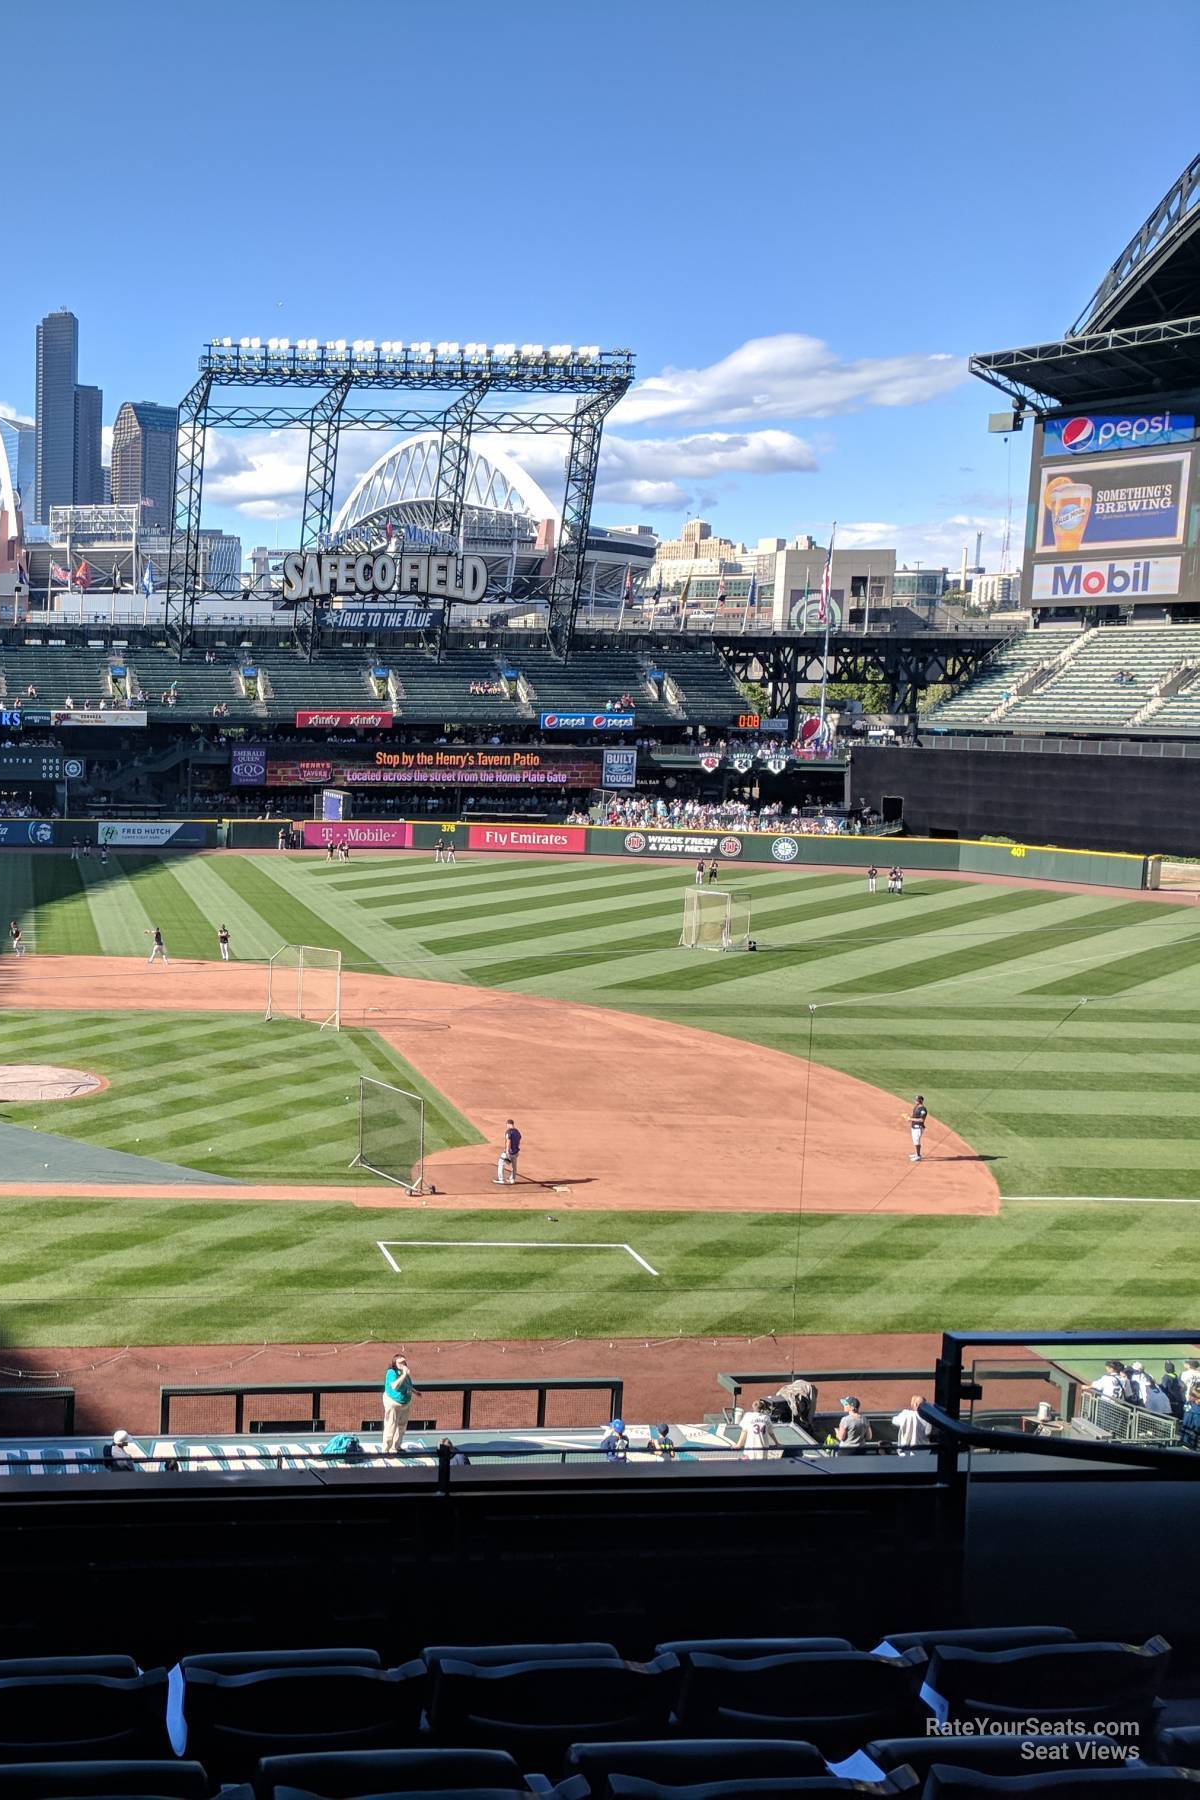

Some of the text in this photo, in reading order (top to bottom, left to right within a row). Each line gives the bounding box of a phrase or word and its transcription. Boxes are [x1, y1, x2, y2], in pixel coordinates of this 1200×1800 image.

[1099, 412, 1171, 444] pepsi
[1096, 484, 1172, 502] SOMETHING'S
[1094, 498, 1172, 515] BREWING
[284, 552, 488, 604] SAFECO FIELD
[1051, 561, 1151, 595] Mobil
[338, 609, 433, 627] TRUE TO THE BLUE
[308, 714, 340, 726] xfinity
[350, 714, 382, 726] xfinity
[560, 717, 585, 727] pepsi
[607, 717, 633, 727] pepsi
[375, 752, 540, 768] Stop by the Henry's Tavern Patio
[606, 754, 633, 764] BUILT
[704, 758, 717, 768] 42
[738, 760, 749, 769] 24
[347, 770, 567, 782] Located across the street from the Home Plate Gate
[606, 774, 632, 782] TOUGH
[441, 824, 455, 833] 376
[485, 831, 568, 846] Fly Emirates
[648, 835, 683, 846] WHERE
[684, 837, 718, 847] FRESH
[650, 843, 657, 851] &
[659, 844, 683, 853] FAST
[684, 845, 713, 854] MEET
[1011, 847, 1026, 857] 401
[753, 1423, 767, 1435] 34
